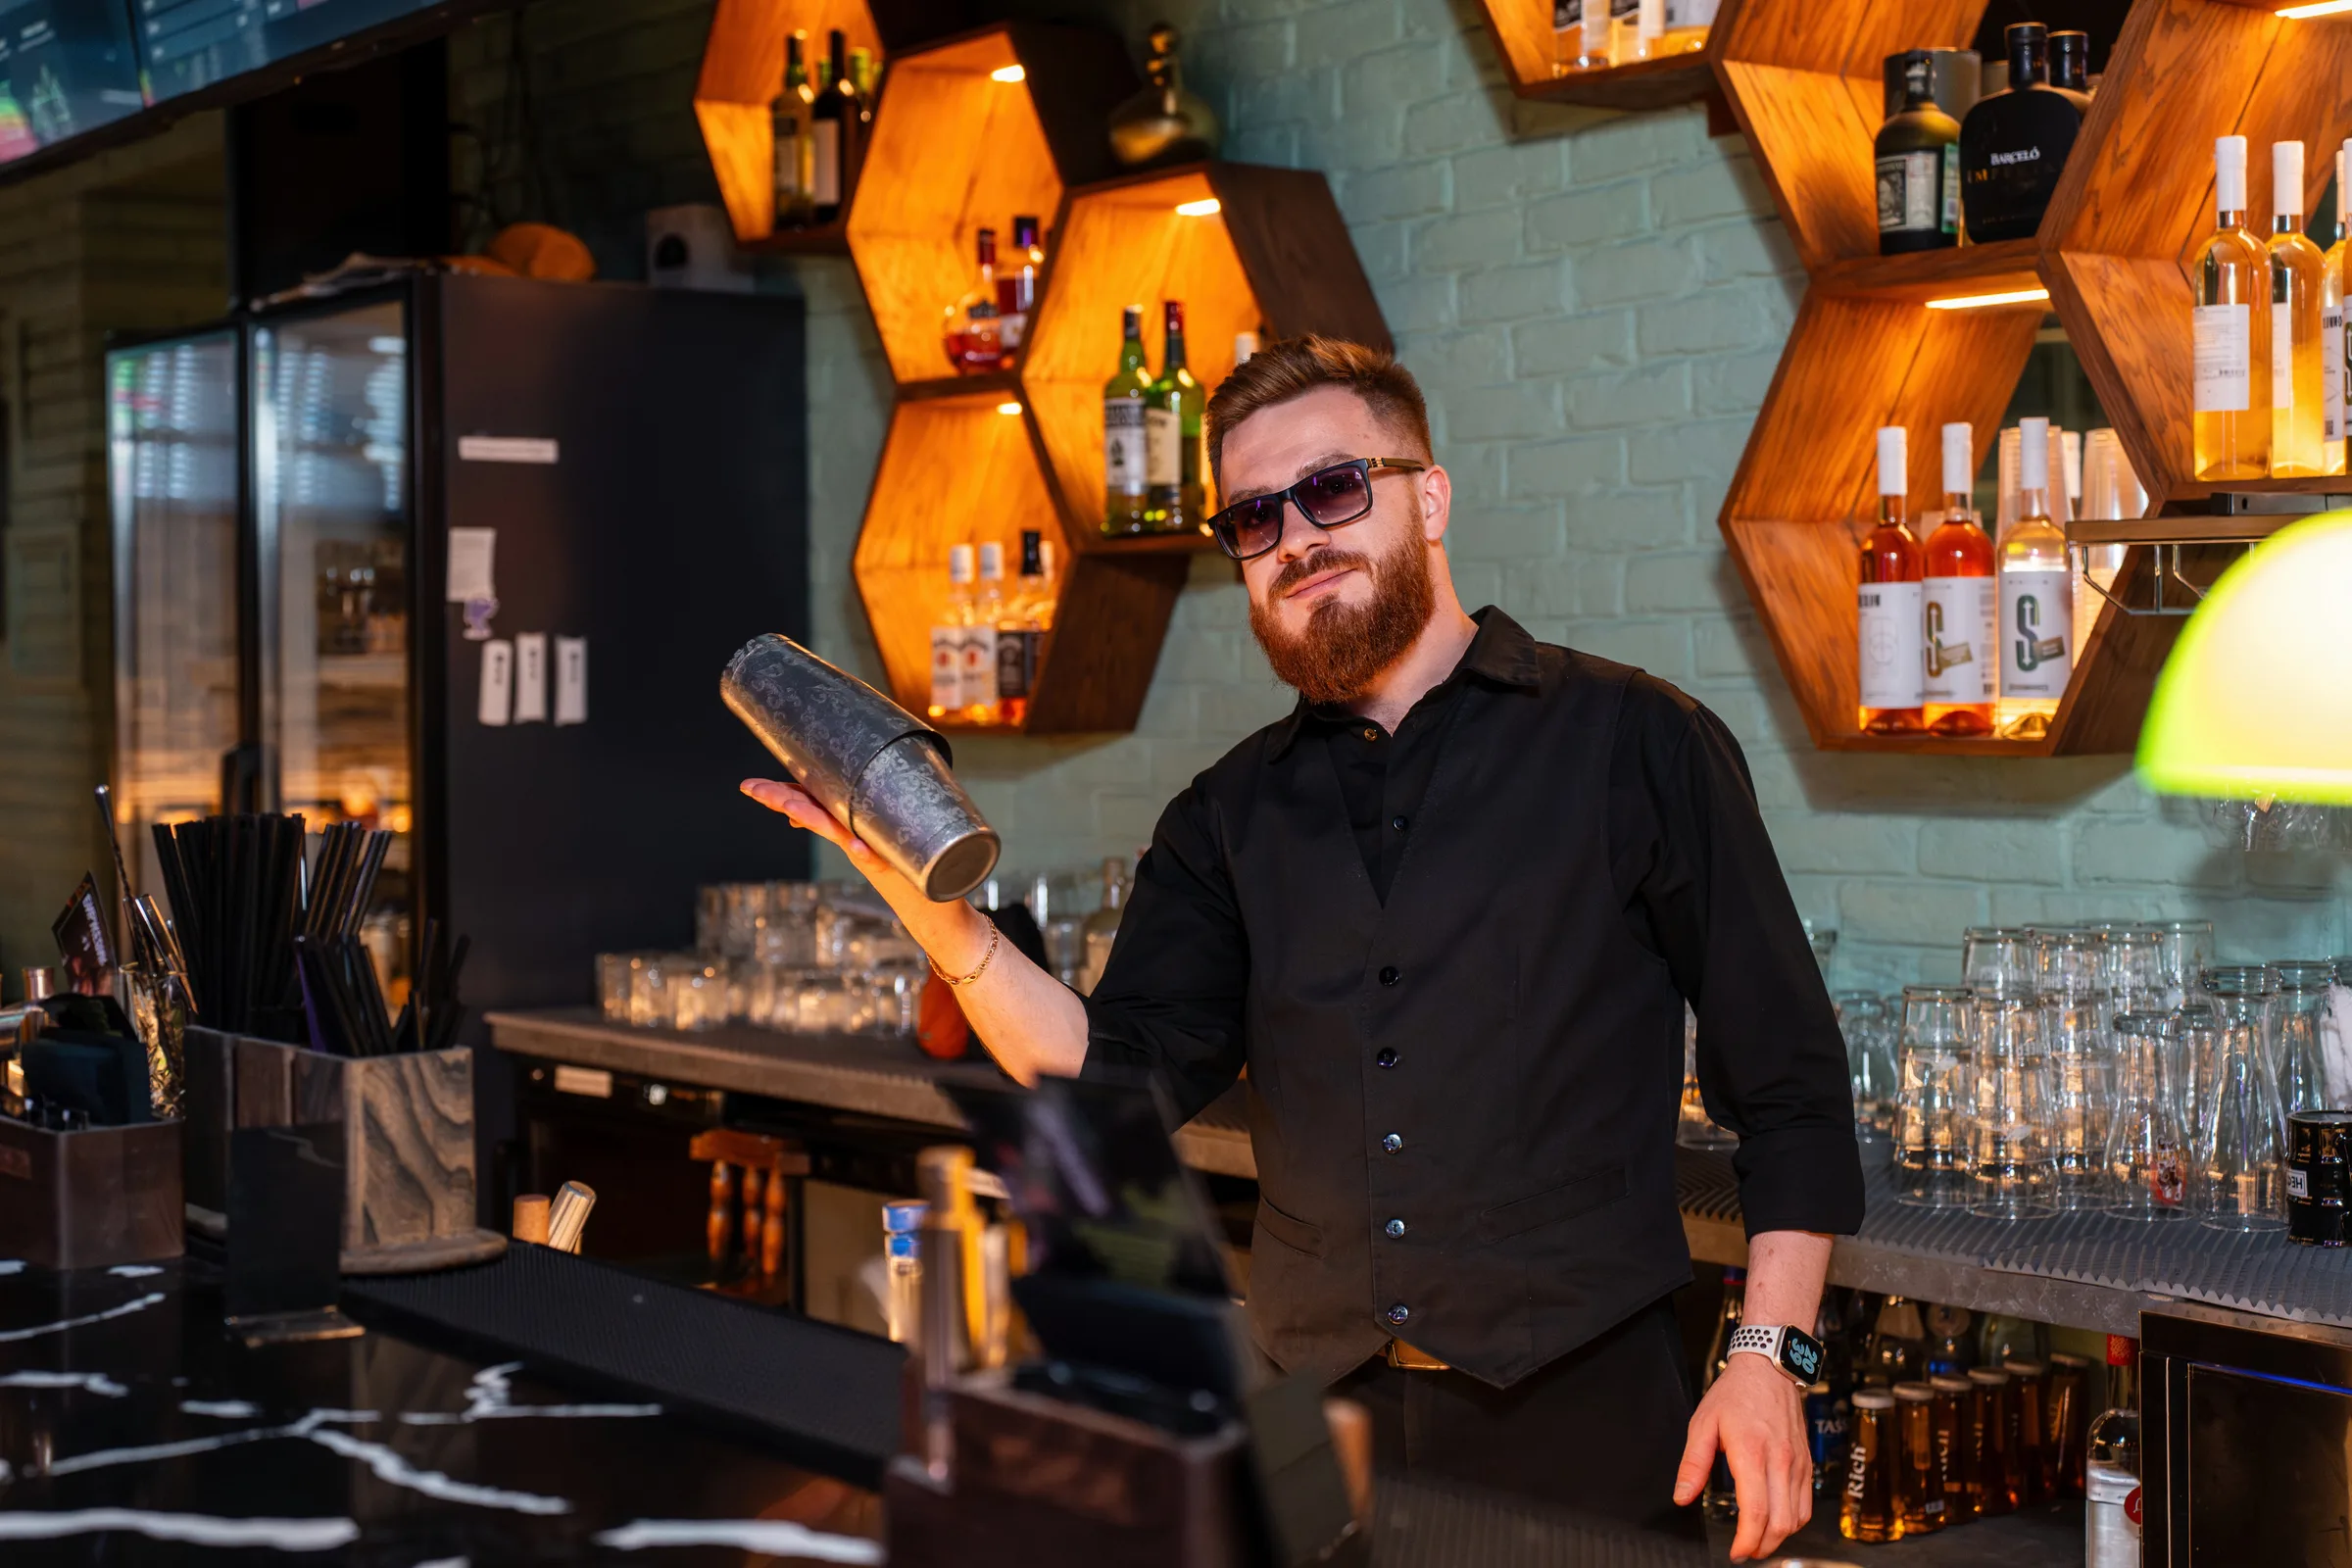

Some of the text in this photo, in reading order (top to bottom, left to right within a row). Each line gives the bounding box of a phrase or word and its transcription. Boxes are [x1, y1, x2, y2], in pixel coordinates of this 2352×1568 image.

[1989, 146, 2041, 166] BARCELÓ
[1789, 1338, 1804, 1366] 39
[1801, 1345, 1818, 1375] 20
[1847, 1446, 1867, 1499] Rich
